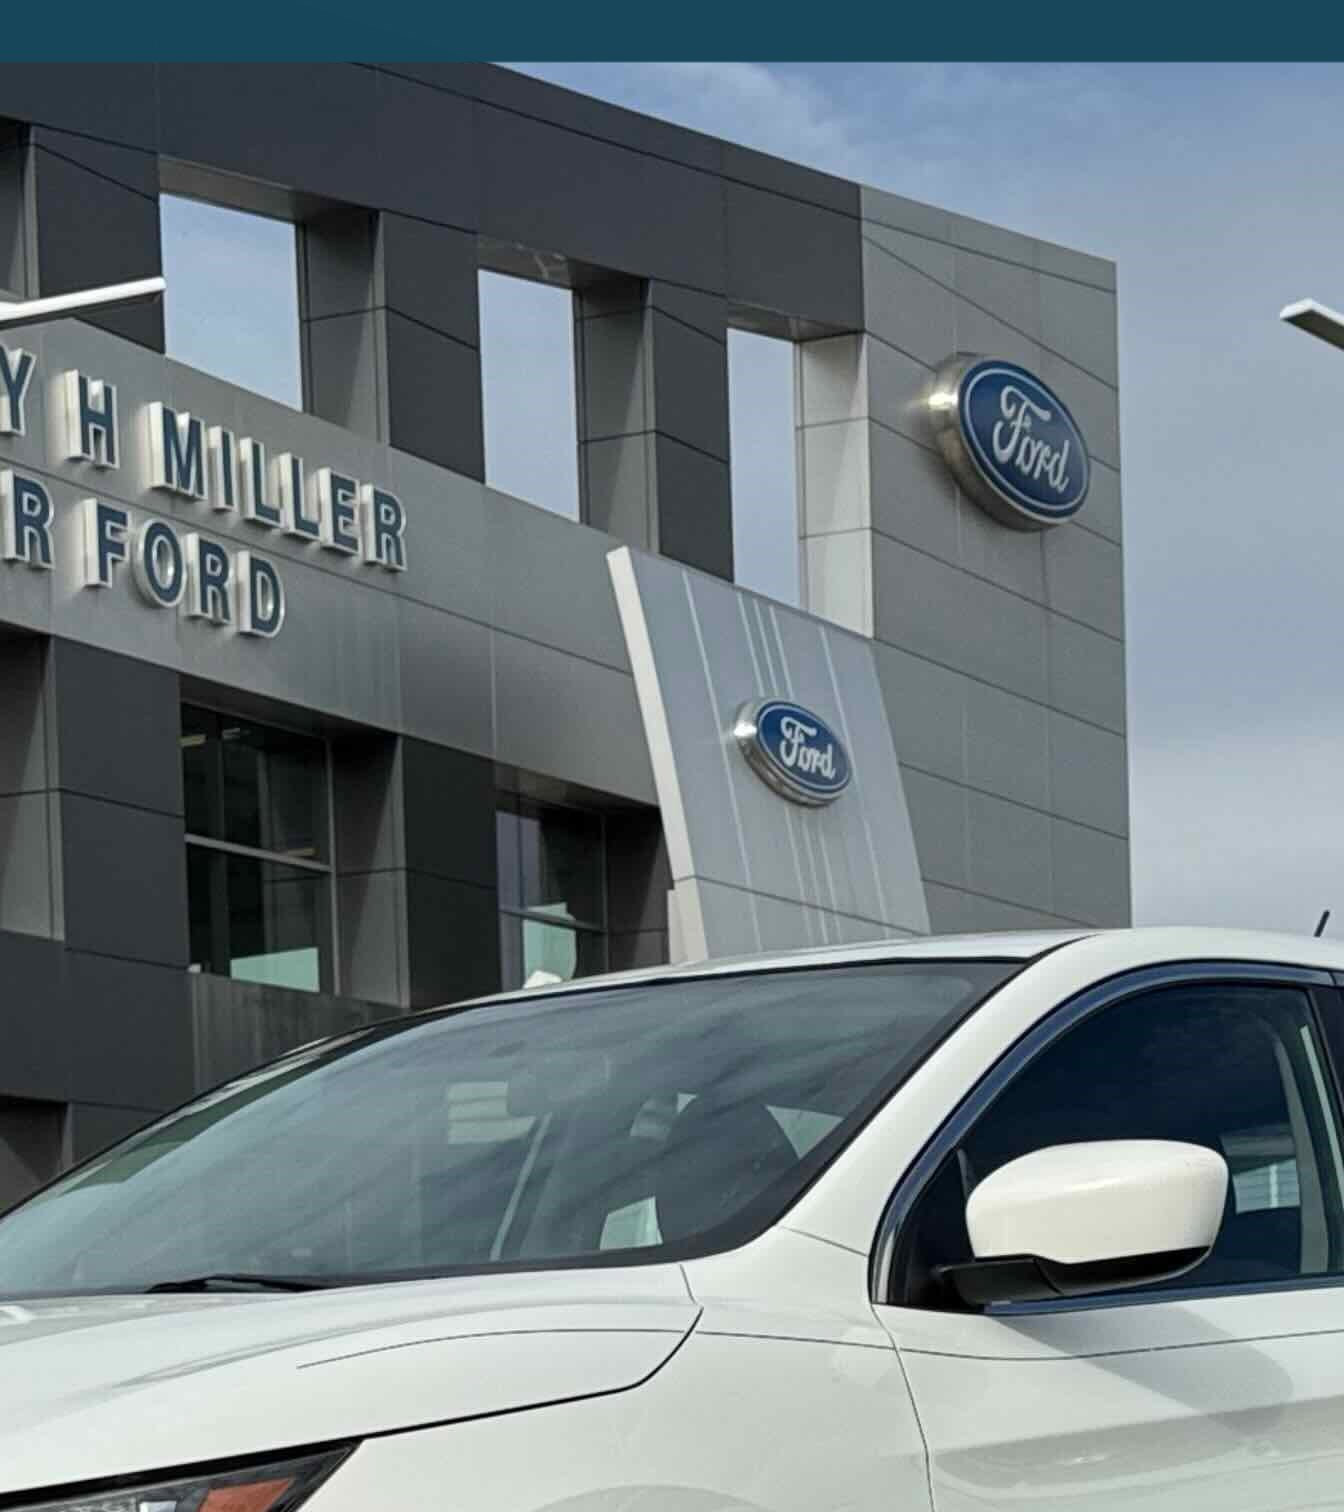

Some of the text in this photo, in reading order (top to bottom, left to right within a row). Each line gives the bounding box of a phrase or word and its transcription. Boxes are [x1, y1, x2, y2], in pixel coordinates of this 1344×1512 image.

[66, 371, 120, 469] H
[150, 402, 407, 573] MILLER
[991, 385, 1071, 494] Ford
[84, 499, 286, 638] FORD
[779, 716, 837, 780] Ford
